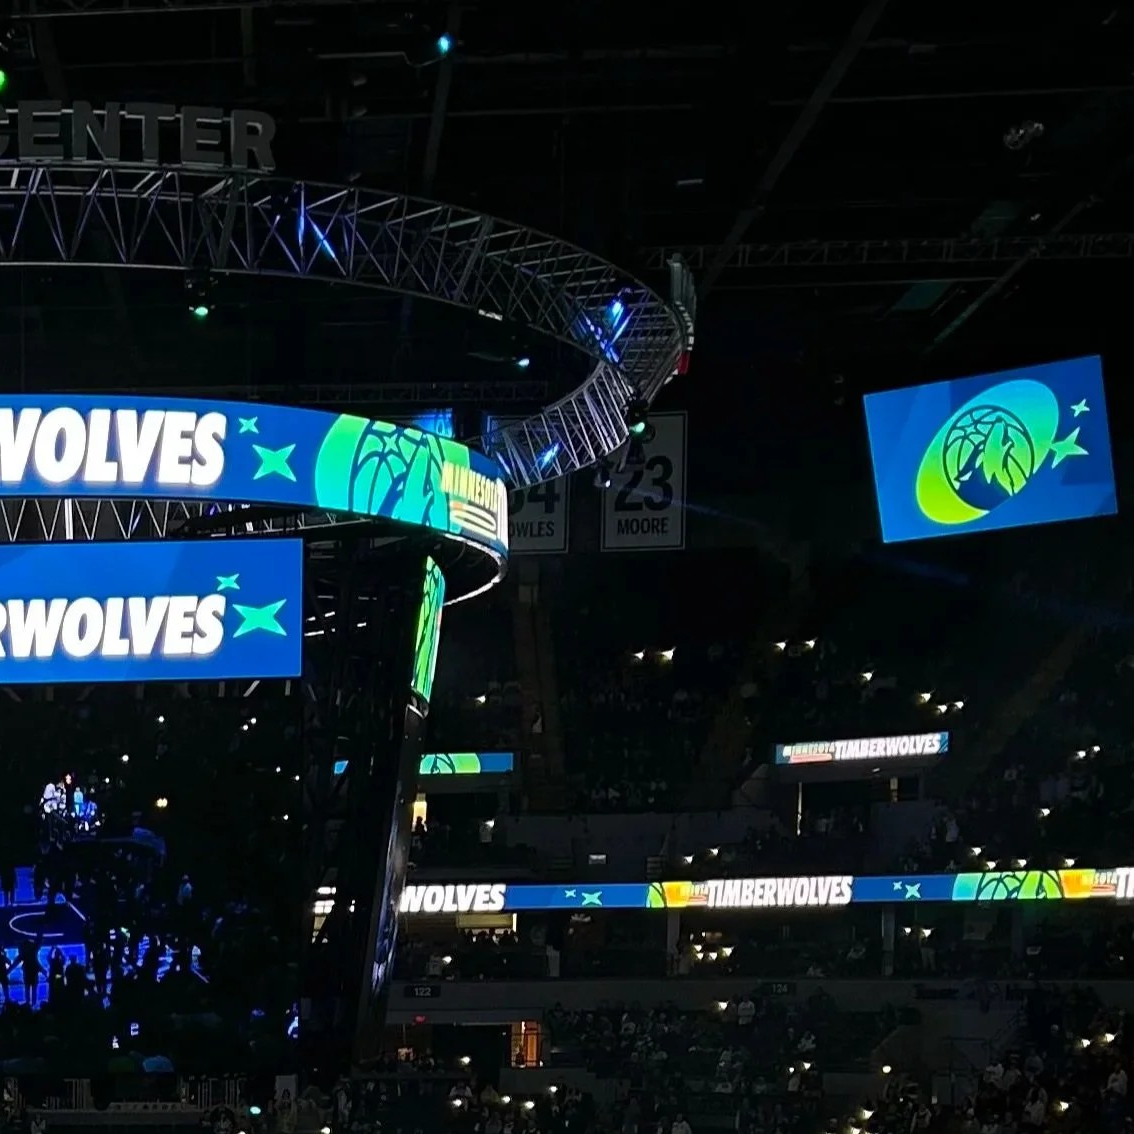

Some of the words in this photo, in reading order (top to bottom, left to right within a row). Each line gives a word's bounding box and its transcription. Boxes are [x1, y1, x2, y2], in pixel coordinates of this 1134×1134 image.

[615, 455, 674, 511] 23
[616, 517, 669, 537] MOORE
[834, 733, 941, 760] TIMBERWOLVES
[707, 875, 853, 907] TIMBERWOLVES
